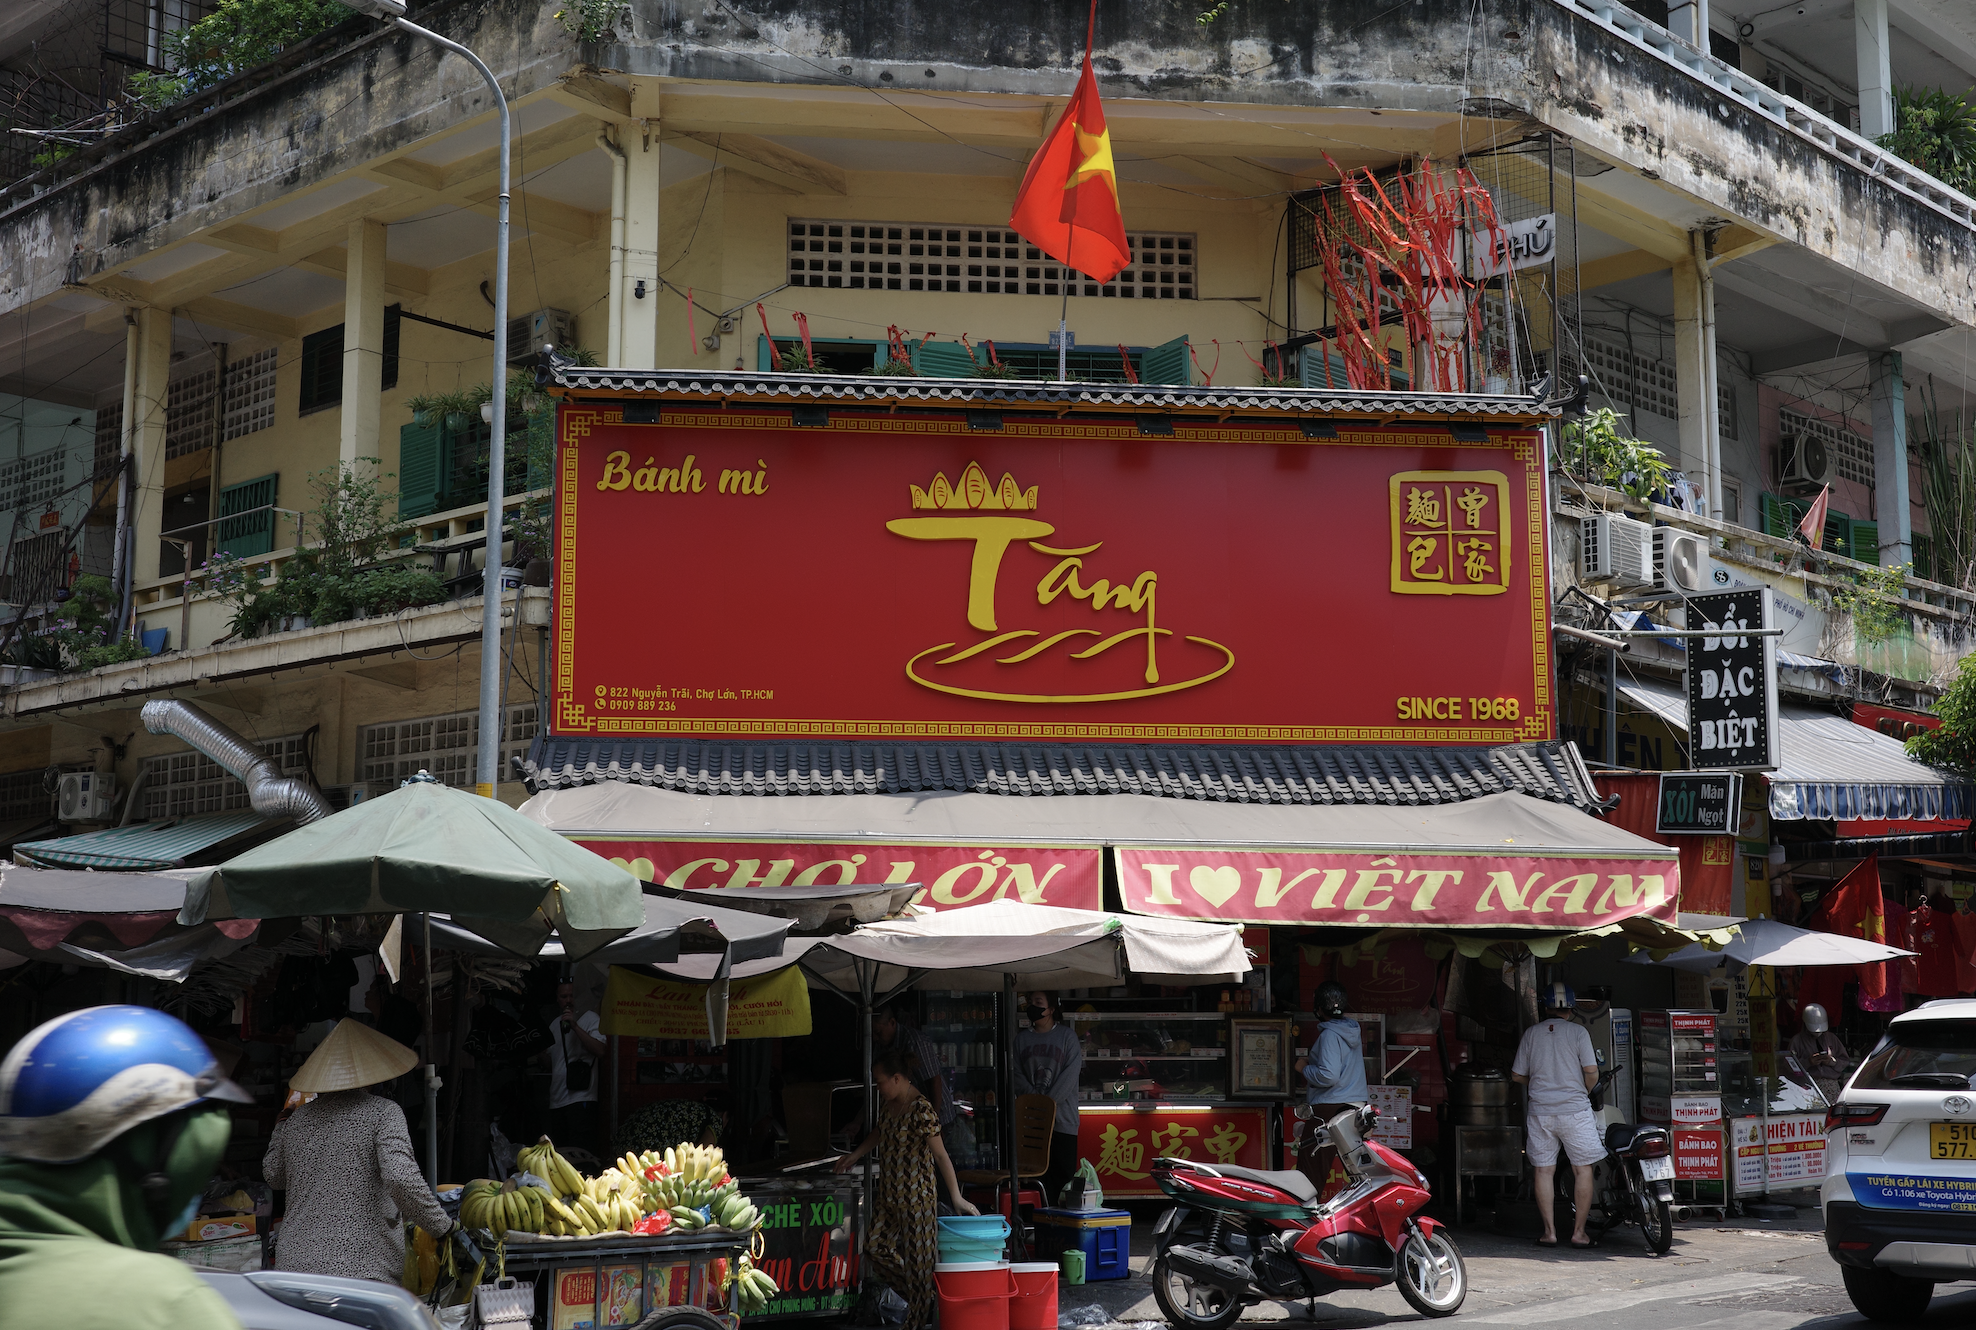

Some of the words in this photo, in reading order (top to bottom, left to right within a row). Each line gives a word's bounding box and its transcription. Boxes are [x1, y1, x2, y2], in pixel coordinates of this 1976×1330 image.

[596, 450, 706, 495] Bánh
[718, 458, 769, 496] mì
[886, 516, 1159, 684] Tăng
[1700, 658, 1754, 707] ĐẶC
[610, 687, 628, 698] 822
[631, 684, 668, 700] Nguyễn
[671, 687, 693, 699] Trãi,
[695, 688, 714, 701] Chợ
[717, 688, 738, 701] Lớn,
[740, 689, 774, 700] TP.HCM
[610, 700, 635, 711] 0909
[637, 701, 655, 711] 889
[658, 701, 676, 711] 236
[1397, 697, 1463, 720] SINCE
[1469, 697, 1520, 721] 1968
[1700, 709, 1759, 757] BIỆT
[1663, 781, 1696, 823] XÔI
[1701, 783, 1724, 804] Mặn
[1697, 807, 1724, 826] Ngọt
[883, 849, 1066, 905] LỚN
[1142, 863, 1182, 904] I
[1255, 859, 1462, 923] VIỆT
[1475, 870, 1668, 914] NAM
[645, 985, 692, 1002] Lan
[743, 1002, 765, 1010] CƯỚI
[766, 1000, 783, 1008] HỎI
[1361, 1005, 1388, 1013] Since
[1675, 1109, 1698, 1119] THỊNH
[1699, 1108, 1718, 1116] PHÁT
[1799, 1118, 1816, 1136] TÀI
[1678, 1139, 1700, 1150] BÁNH
[1701, 1140, 1717, 1150] BAO
[1678, 1157, 1700, 1170] THỊNH
[1700, 1154, 1719, 1167] PHÁT
[1867, 1175, 1896, 1187] TUYỂN
[1897, 1176, 1915, 1188] GẤP
[1917, 1178, 1931, 1189] LÁI
[1933, 1180, 1945, 1189] XE
[1946, 1181, 1976, 1191] HYBRI
[1882, 1188, 1893, 1197] Có
[1894, 1189, 1915, 1198] 1.106
[1926, 1191, 1954, 1201] Toyota
[761, 1197, 801, 1229] CHÈ
[809, 1195, 844, 1226] XÔI
[798, 1231, 860, 1292] Anh
